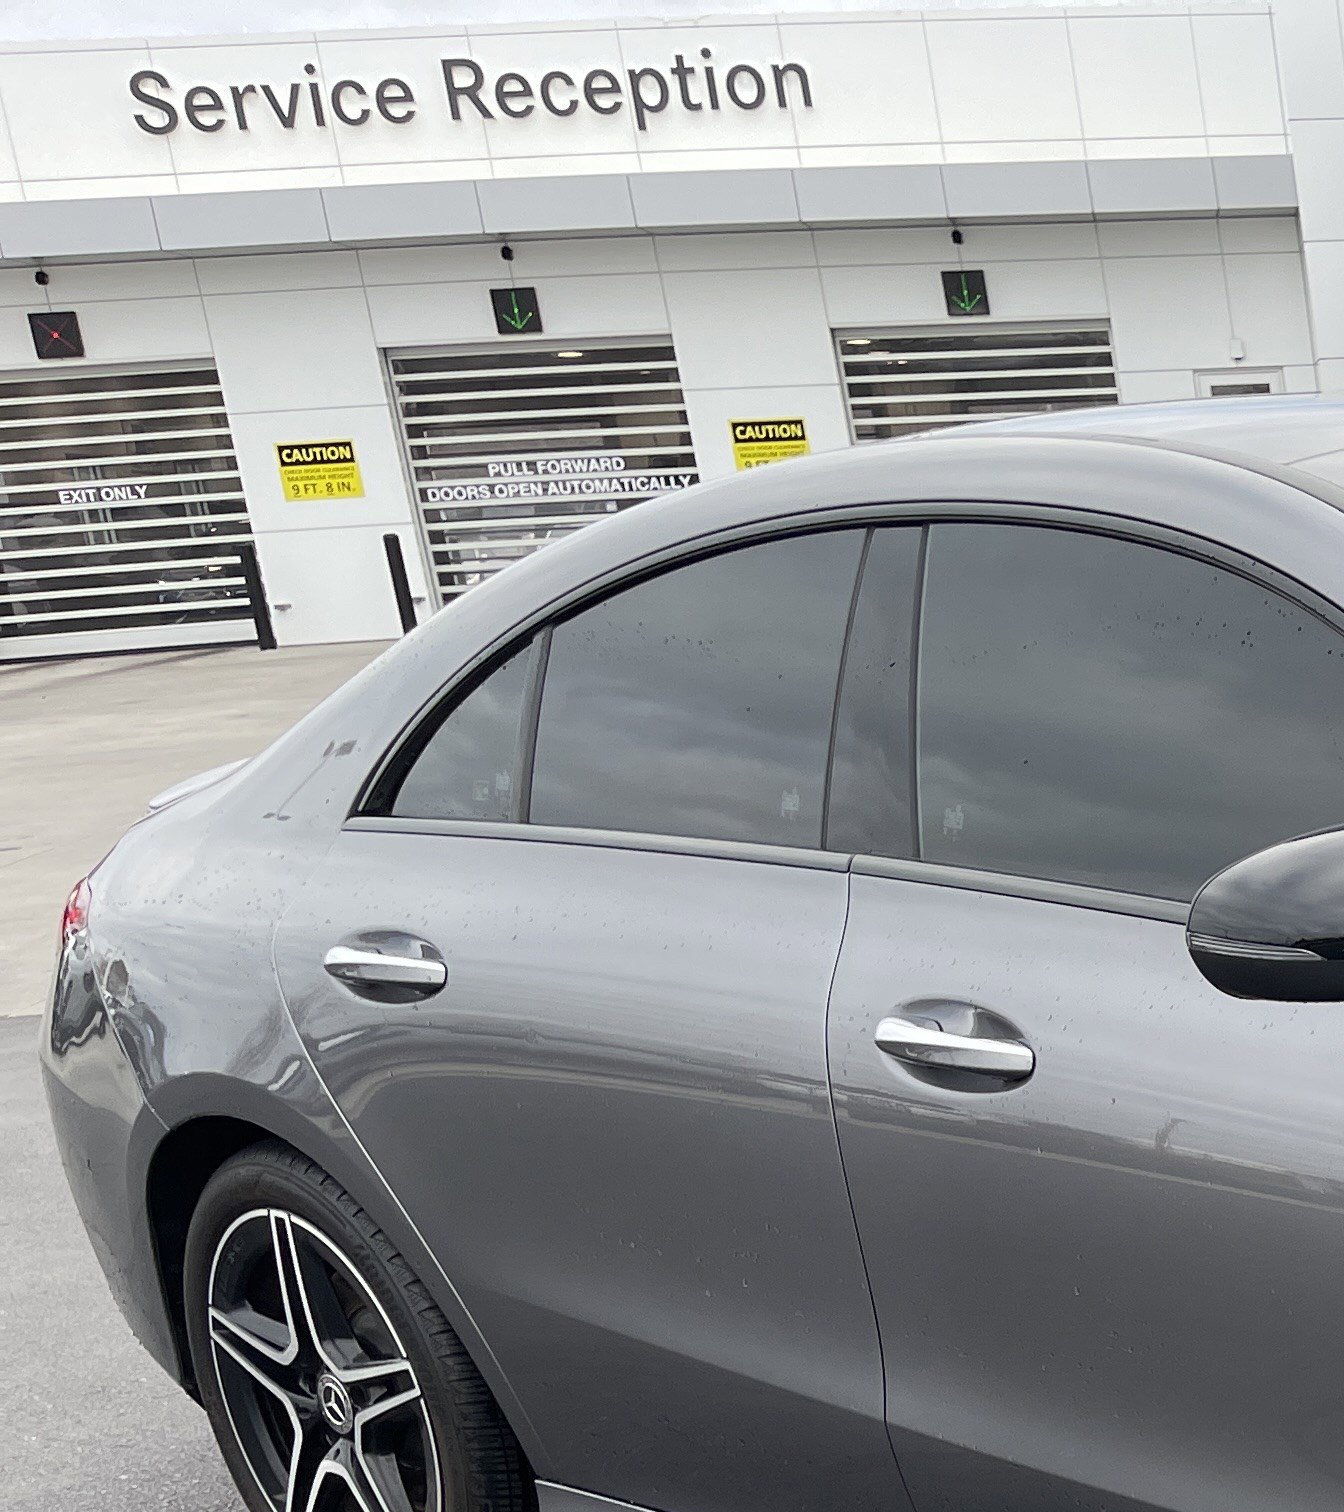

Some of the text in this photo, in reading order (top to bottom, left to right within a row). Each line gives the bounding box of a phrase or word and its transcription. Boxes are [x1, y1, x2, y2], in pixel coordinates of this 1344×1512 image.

[128, 47, 813, 135] Service Reception
[735, 423, 803, 440] CAUTION
[281, 445, 352, 463] CAUTION
[488, 457, 625, 478] PULL FORWARD
[58, 485, 148, 504] EXIT ONLY
[292, 484, 300, 495] 9
[427, 475, 692, 502] DOORS OPEN AUTOMATICALLY
